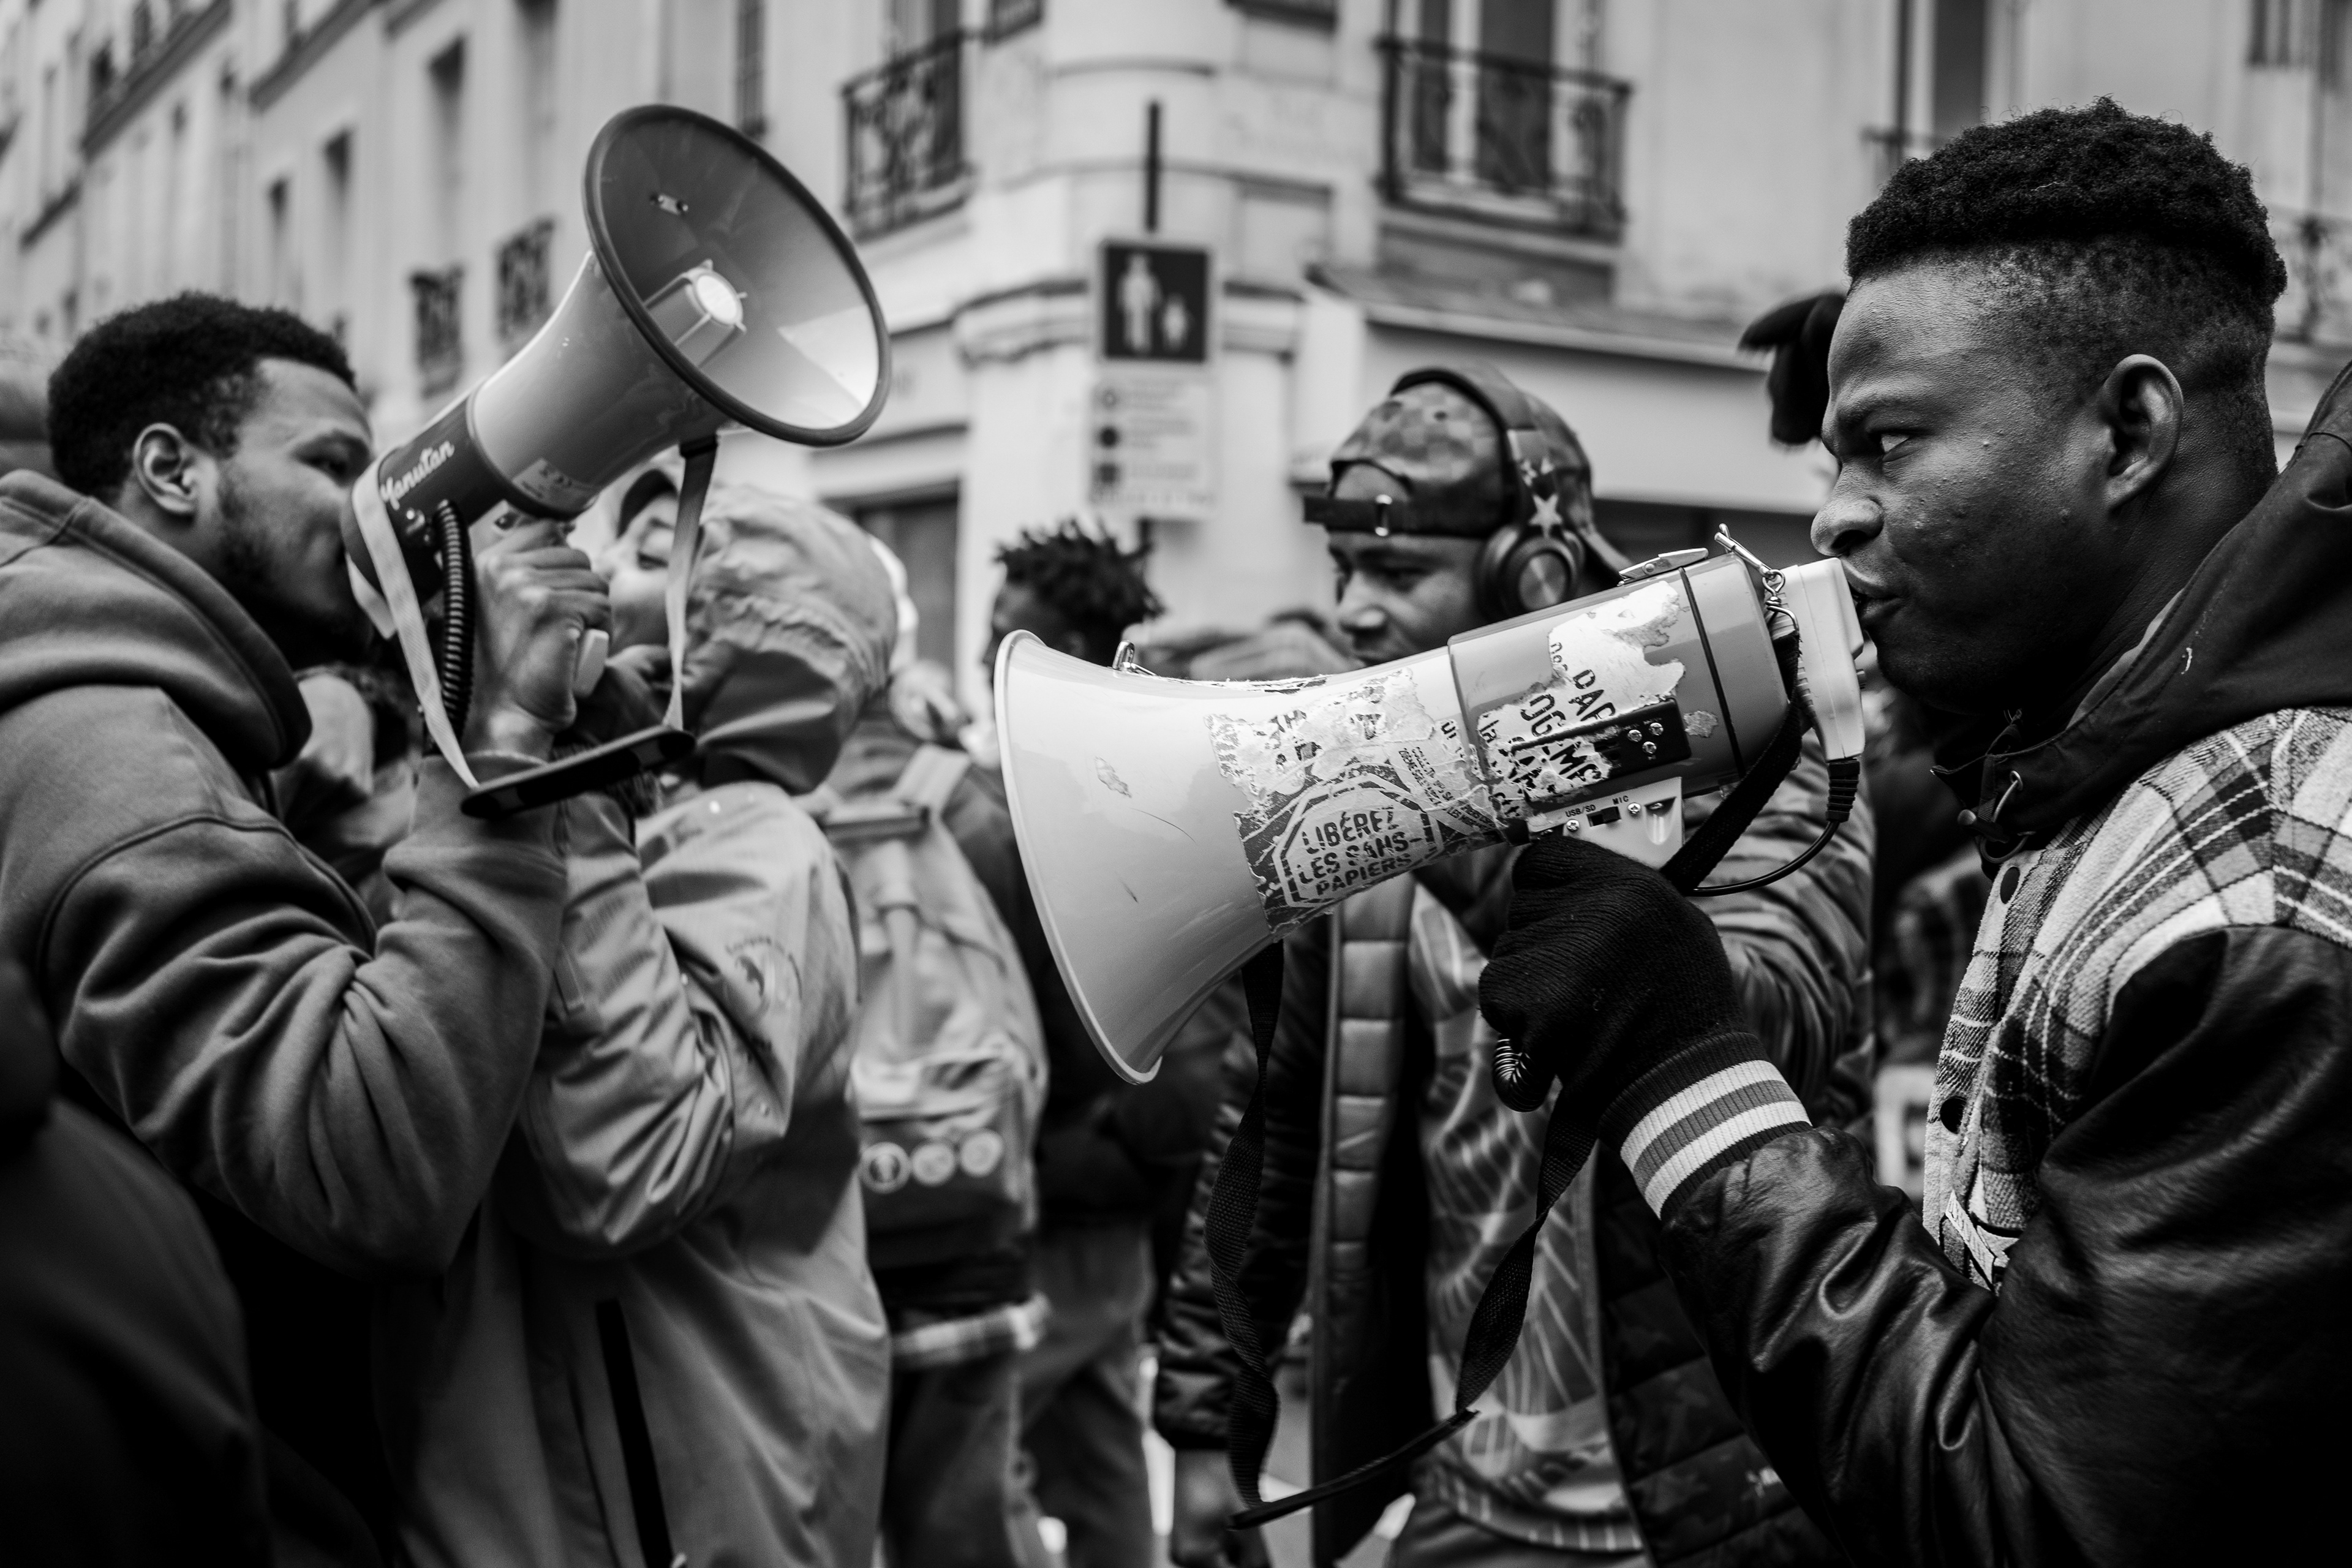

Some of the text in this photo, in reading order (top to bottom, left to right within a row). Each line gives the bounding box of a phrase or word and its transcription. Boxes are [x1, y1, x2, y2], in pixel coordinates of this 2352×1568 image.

[1565, 804, 1596, 818] USB/SD
[1612, 796, 1629, 805] MIC
[1302, 805, 1400, 854] LIBÉREZ
[1297, 831, 1423, 884] LES SANS-
[1316, 853, 1412, 895] PAPIERS
